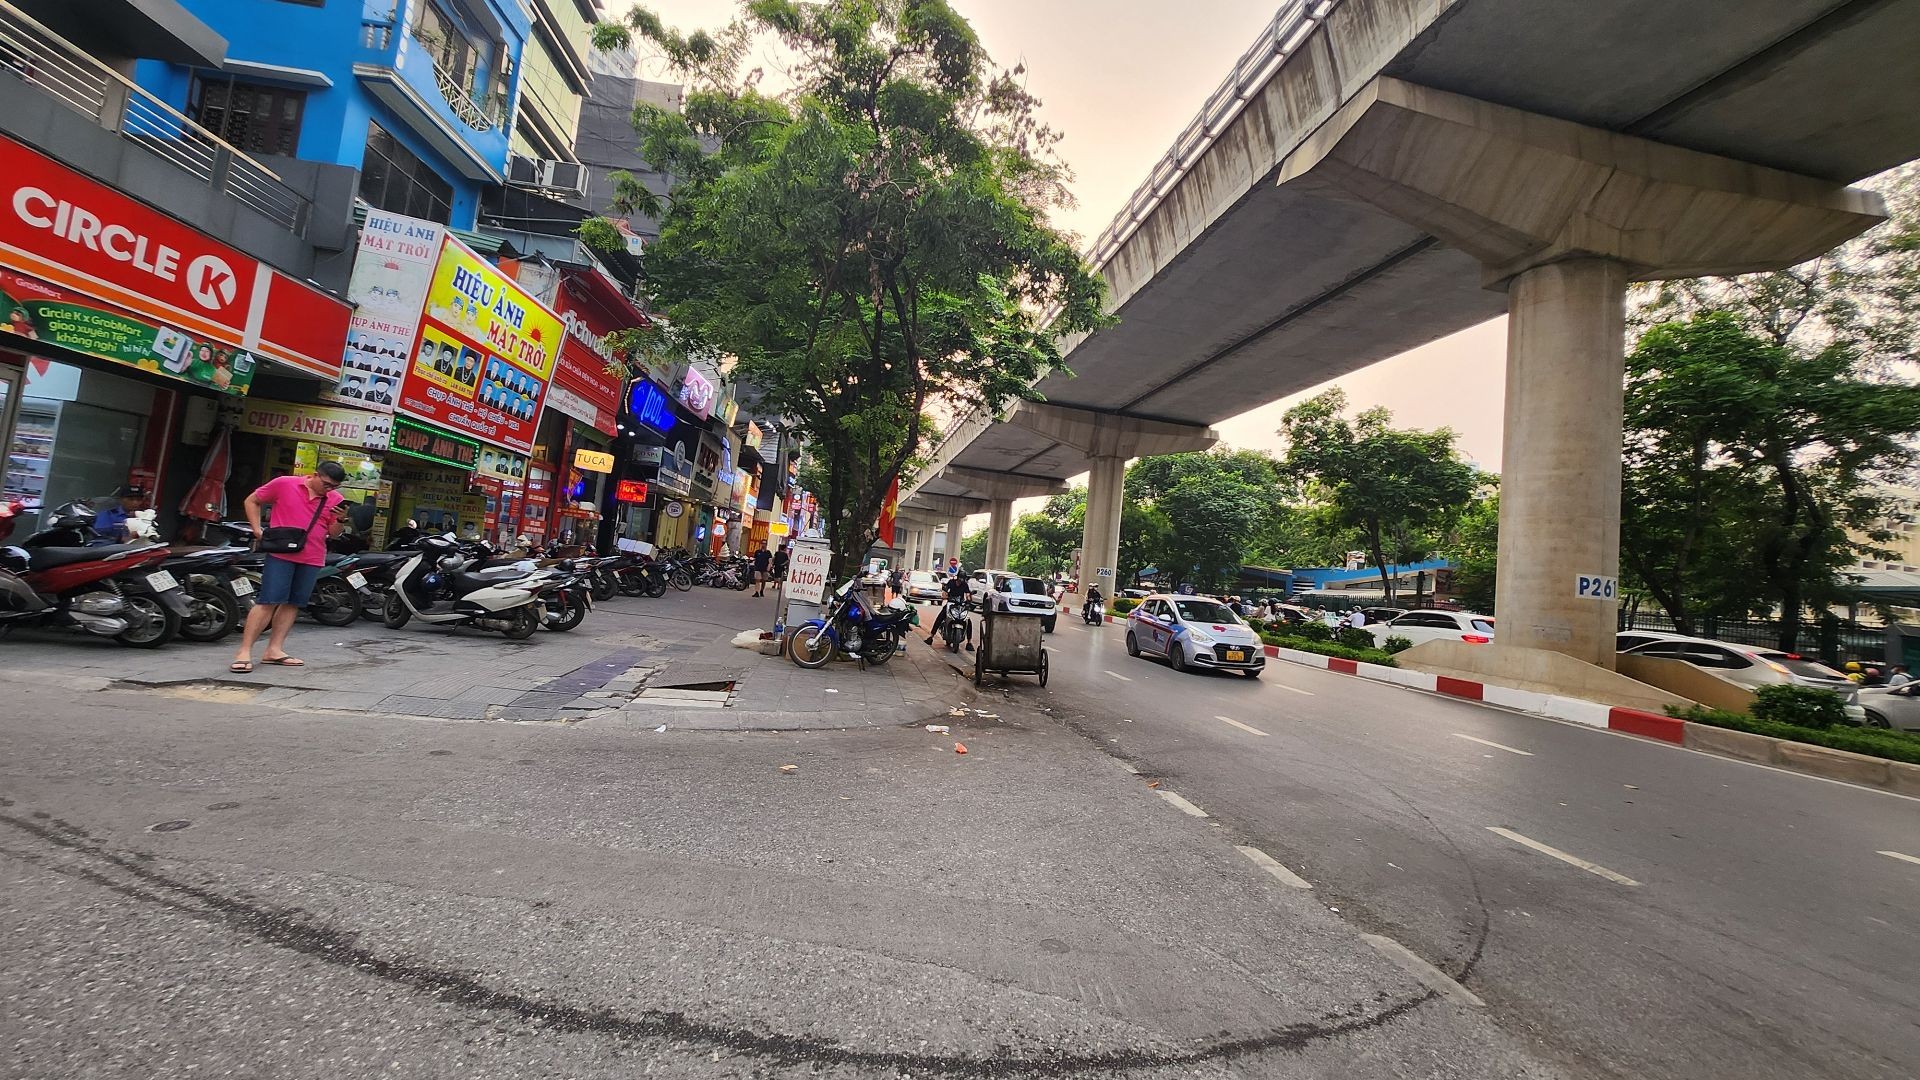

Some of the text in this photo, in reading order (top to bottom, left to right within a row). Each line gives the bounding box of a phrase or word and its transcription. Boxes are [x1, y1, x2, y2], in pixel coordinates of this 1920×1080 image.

[368, 217, 436, 242] HIỆU ẢNH
[13, 187, 232, 308] CIRCLE K
[399, 241, 431, 259] TRỜI
[15, 278, 62, 300] GrabMart
[452, 266, 526, 330] HIỆU ẢNH
[38, 307, 142, 338] Circle K x GrabMart
[49, 319, 75, 332] giao
[77, 324, 110, 341] xuyên
[369, 318, 391, 332] ẢNH
[392, 324, 413, 337] THẺ
[56, 331, 93, 349] không
[519, 342, 548, 371] TRỜI
[427, 387, 446, 402] CHỤP
[446, 392, 461, 408] ẢNH
[461, 401, 474, 413] THẺ
[248, 409, 360, 440] CHỤP ẢNH THẺ
[448, 412, 471, 427] CHUẨN
[577, 453, 606, 467] TUCA
[797, 552, 822, 565] CHỮA
[1096, 568, 1112, 576] P260
[1579, 576, 1617, 598] P261
